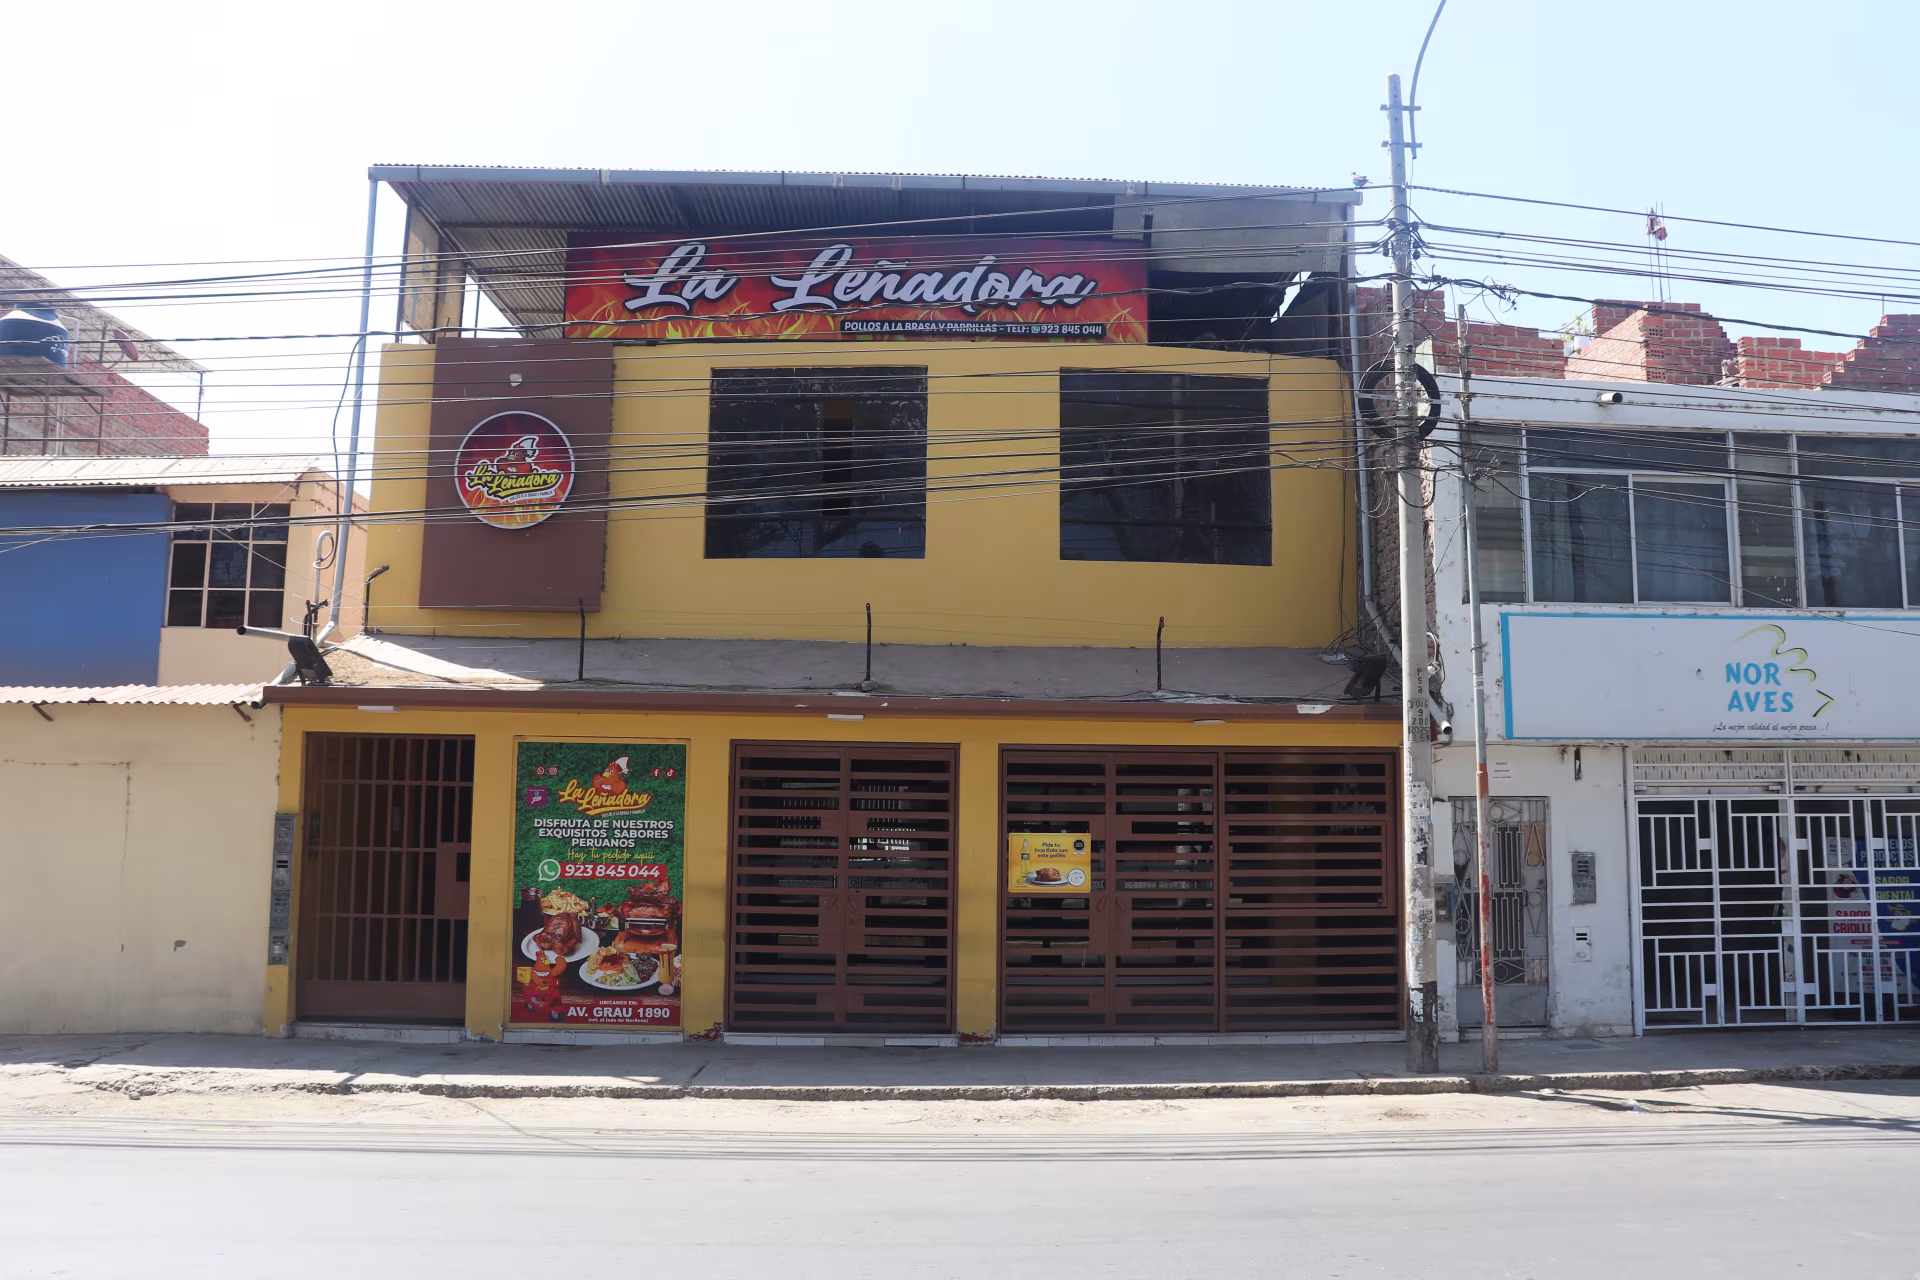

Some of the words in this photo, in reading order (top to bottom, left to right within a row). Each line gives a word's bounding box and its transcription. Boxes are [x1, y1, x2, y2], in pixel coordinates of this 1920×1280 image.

[623, 243, 740, 312] La
[771, 244, 1096, 313] Leñadora
[844, 321, 881, 332] POLLOS
[882, 321, 890, 331] A
[891, 321, 904, 332] LA
[904, 322, 937, 332] BRASA
[938, 322, 947, 332] Y
[946, 322, 997, 333] PARRILLAS
[1040, 324, 1060, 334] 923
[1061, 324, 1080, 334] 845
[1082, 325, 1102, 335] 044
[1726, 662, 1781, 686] NOR
[1727, 690, 1794, 713] AVES
[1728, 723, 1746, 732] mejor
[1747, 722, 1770, 731] calidad
[1781, 723, 1797, 732] mejor
[558, 779, 587, 804] La
[577, 786, 652, 812] Leñadora
[534, 818, 590, 829] DISFRUTA
[593, 819, 609, 829] DE
[612, 820, 674, 830] NUESTROS
[538, 828, 607, 839] EXQUISITOS
[613, 830, 669, 839] SABORES
[571, 838, 635, 848] PERUANOS
[567, 848, 587, 864] Haz
[602, 848, 631, 863] pedido
[565, 864, 593, 877] 923
[595, 864, 626, 877] 845
[628, 865, 660, 878] 044
[567, 1006, 588, 1017] AV.
[593, 1006, 633, 1018] GRAU
[637, 1007, 670, 1018] 1890
